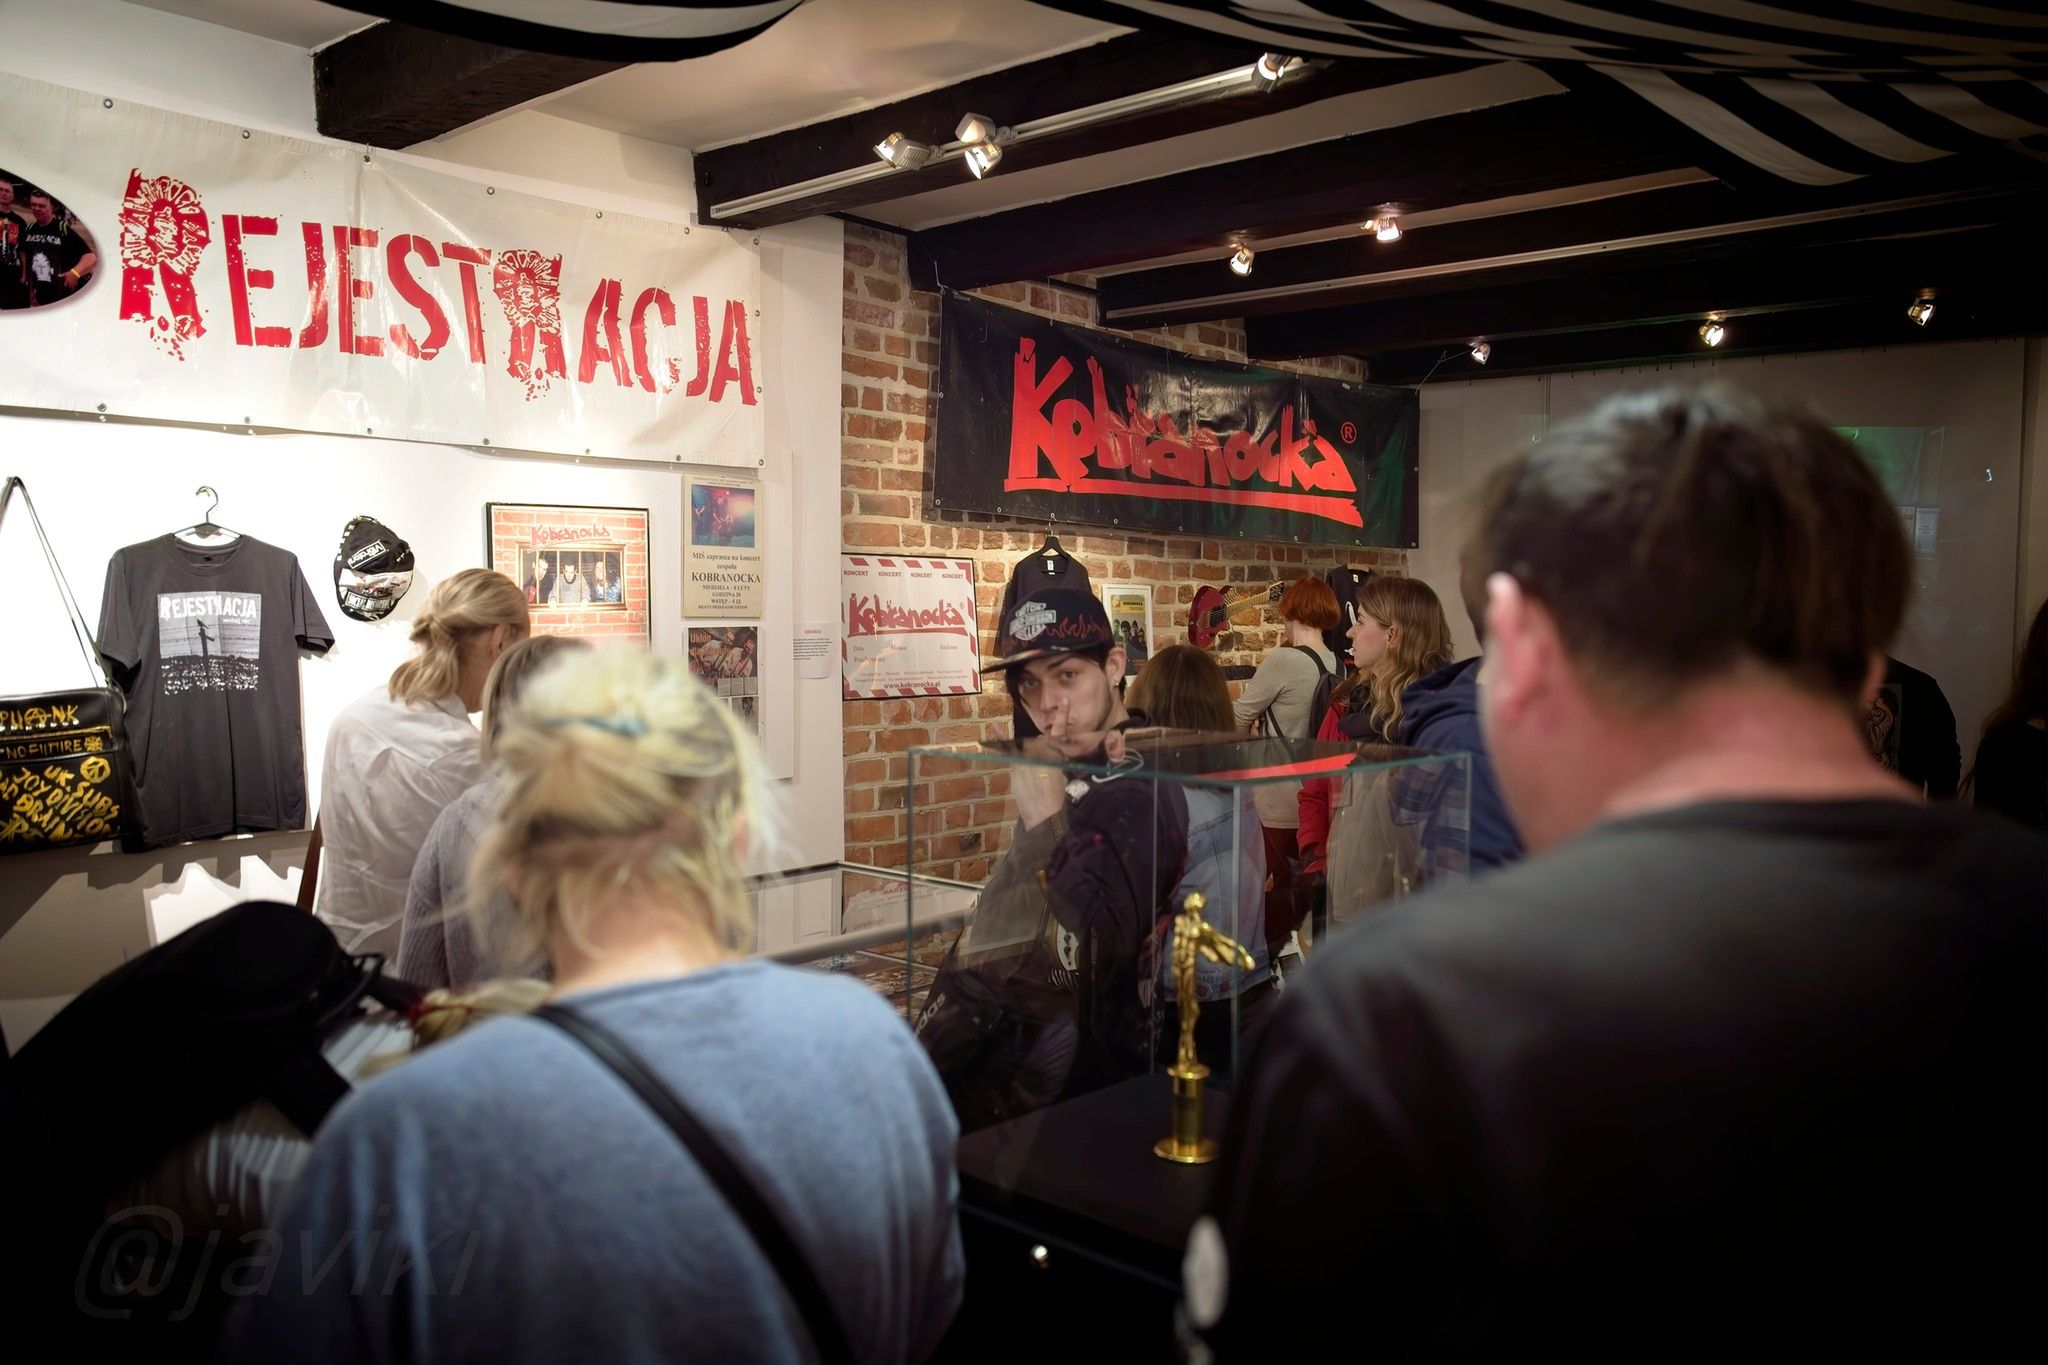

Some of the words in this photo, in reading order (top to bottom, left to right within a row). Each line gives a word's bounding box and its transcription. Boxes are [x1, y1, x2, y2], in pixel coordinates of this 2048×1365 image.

[118, 167, 757, 405] REJESTRACJA
[691, 571, 761, 583] KOBRANOCKA
[160, 594, 257, 620] REJESTRACJA
[849, 593, 965, 635] Kobranocka
[883, 680, 941, 689] www.kobranocka.pl
